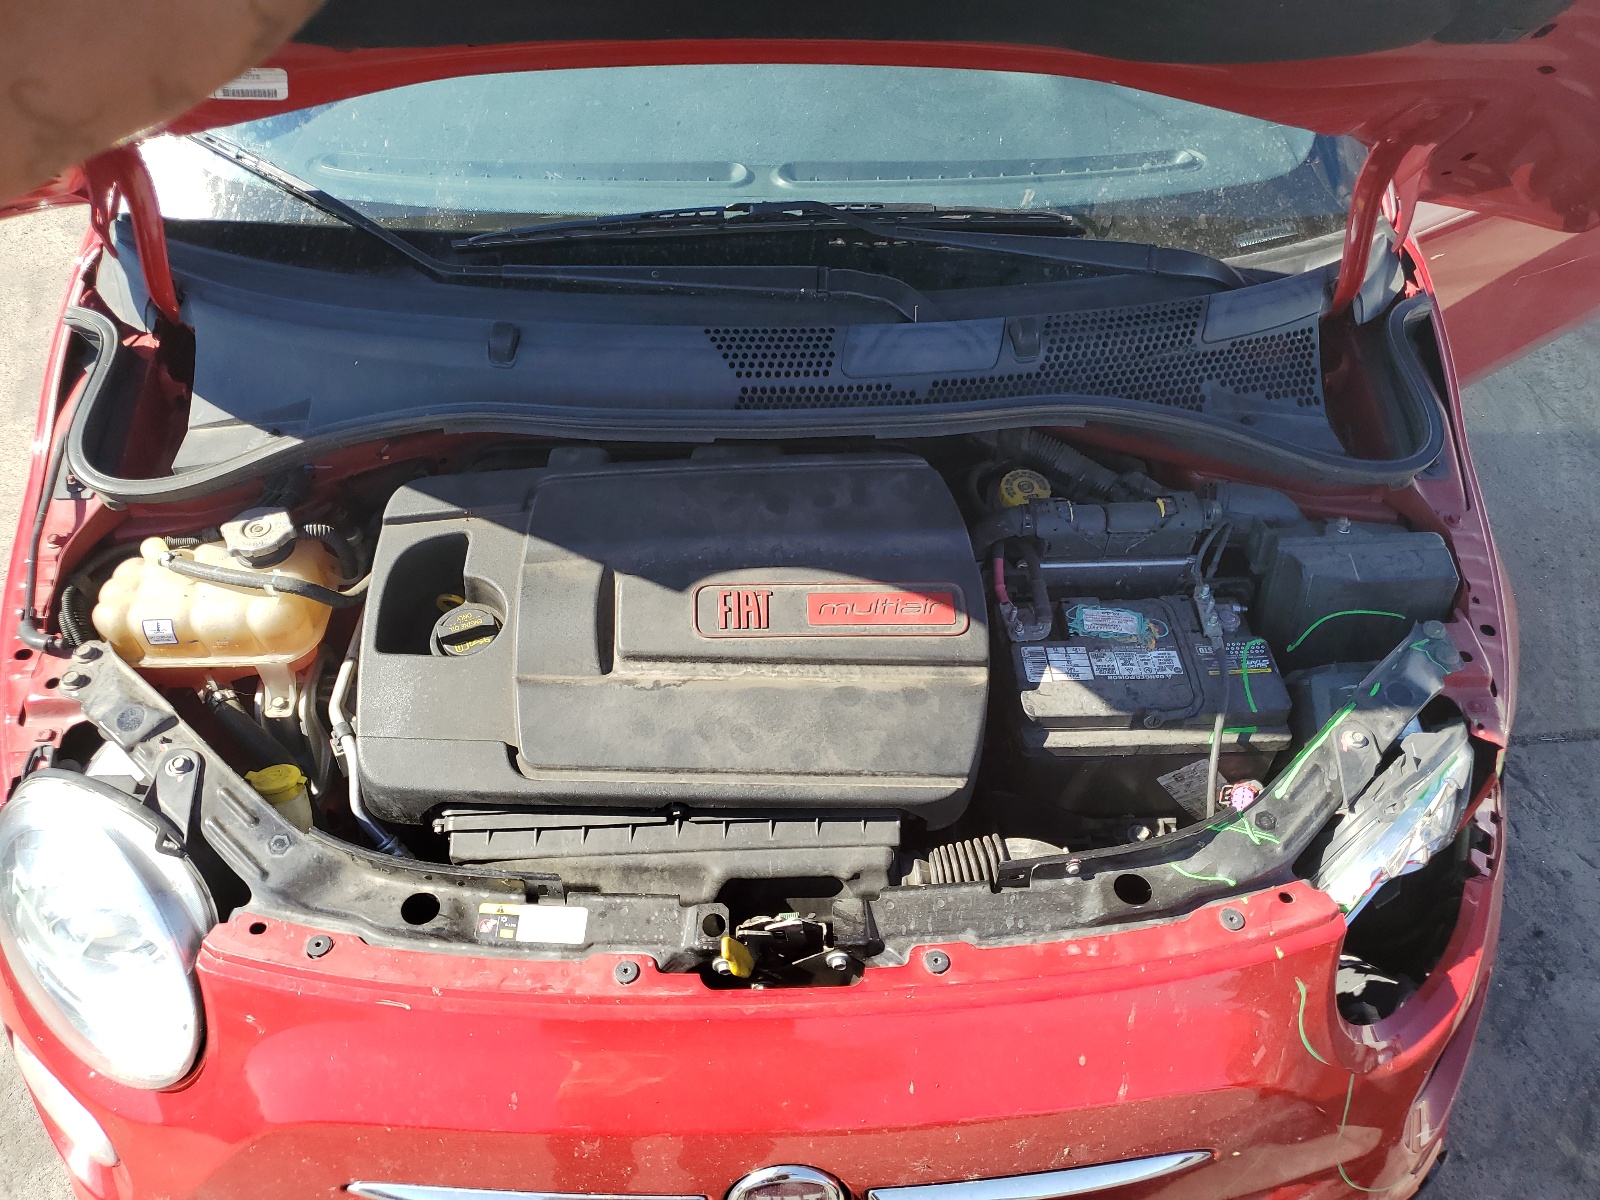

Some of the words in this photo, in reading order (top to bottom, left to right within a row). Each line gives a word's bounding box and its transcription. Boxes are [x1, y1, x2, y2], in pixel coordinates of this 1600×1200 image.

[718, 590, 773, 630] FIAT
[818, 598, 942, 616] multiair
[457, 613, 472, 621] ONLY
[461, 618, 482, 629] ENGINE
